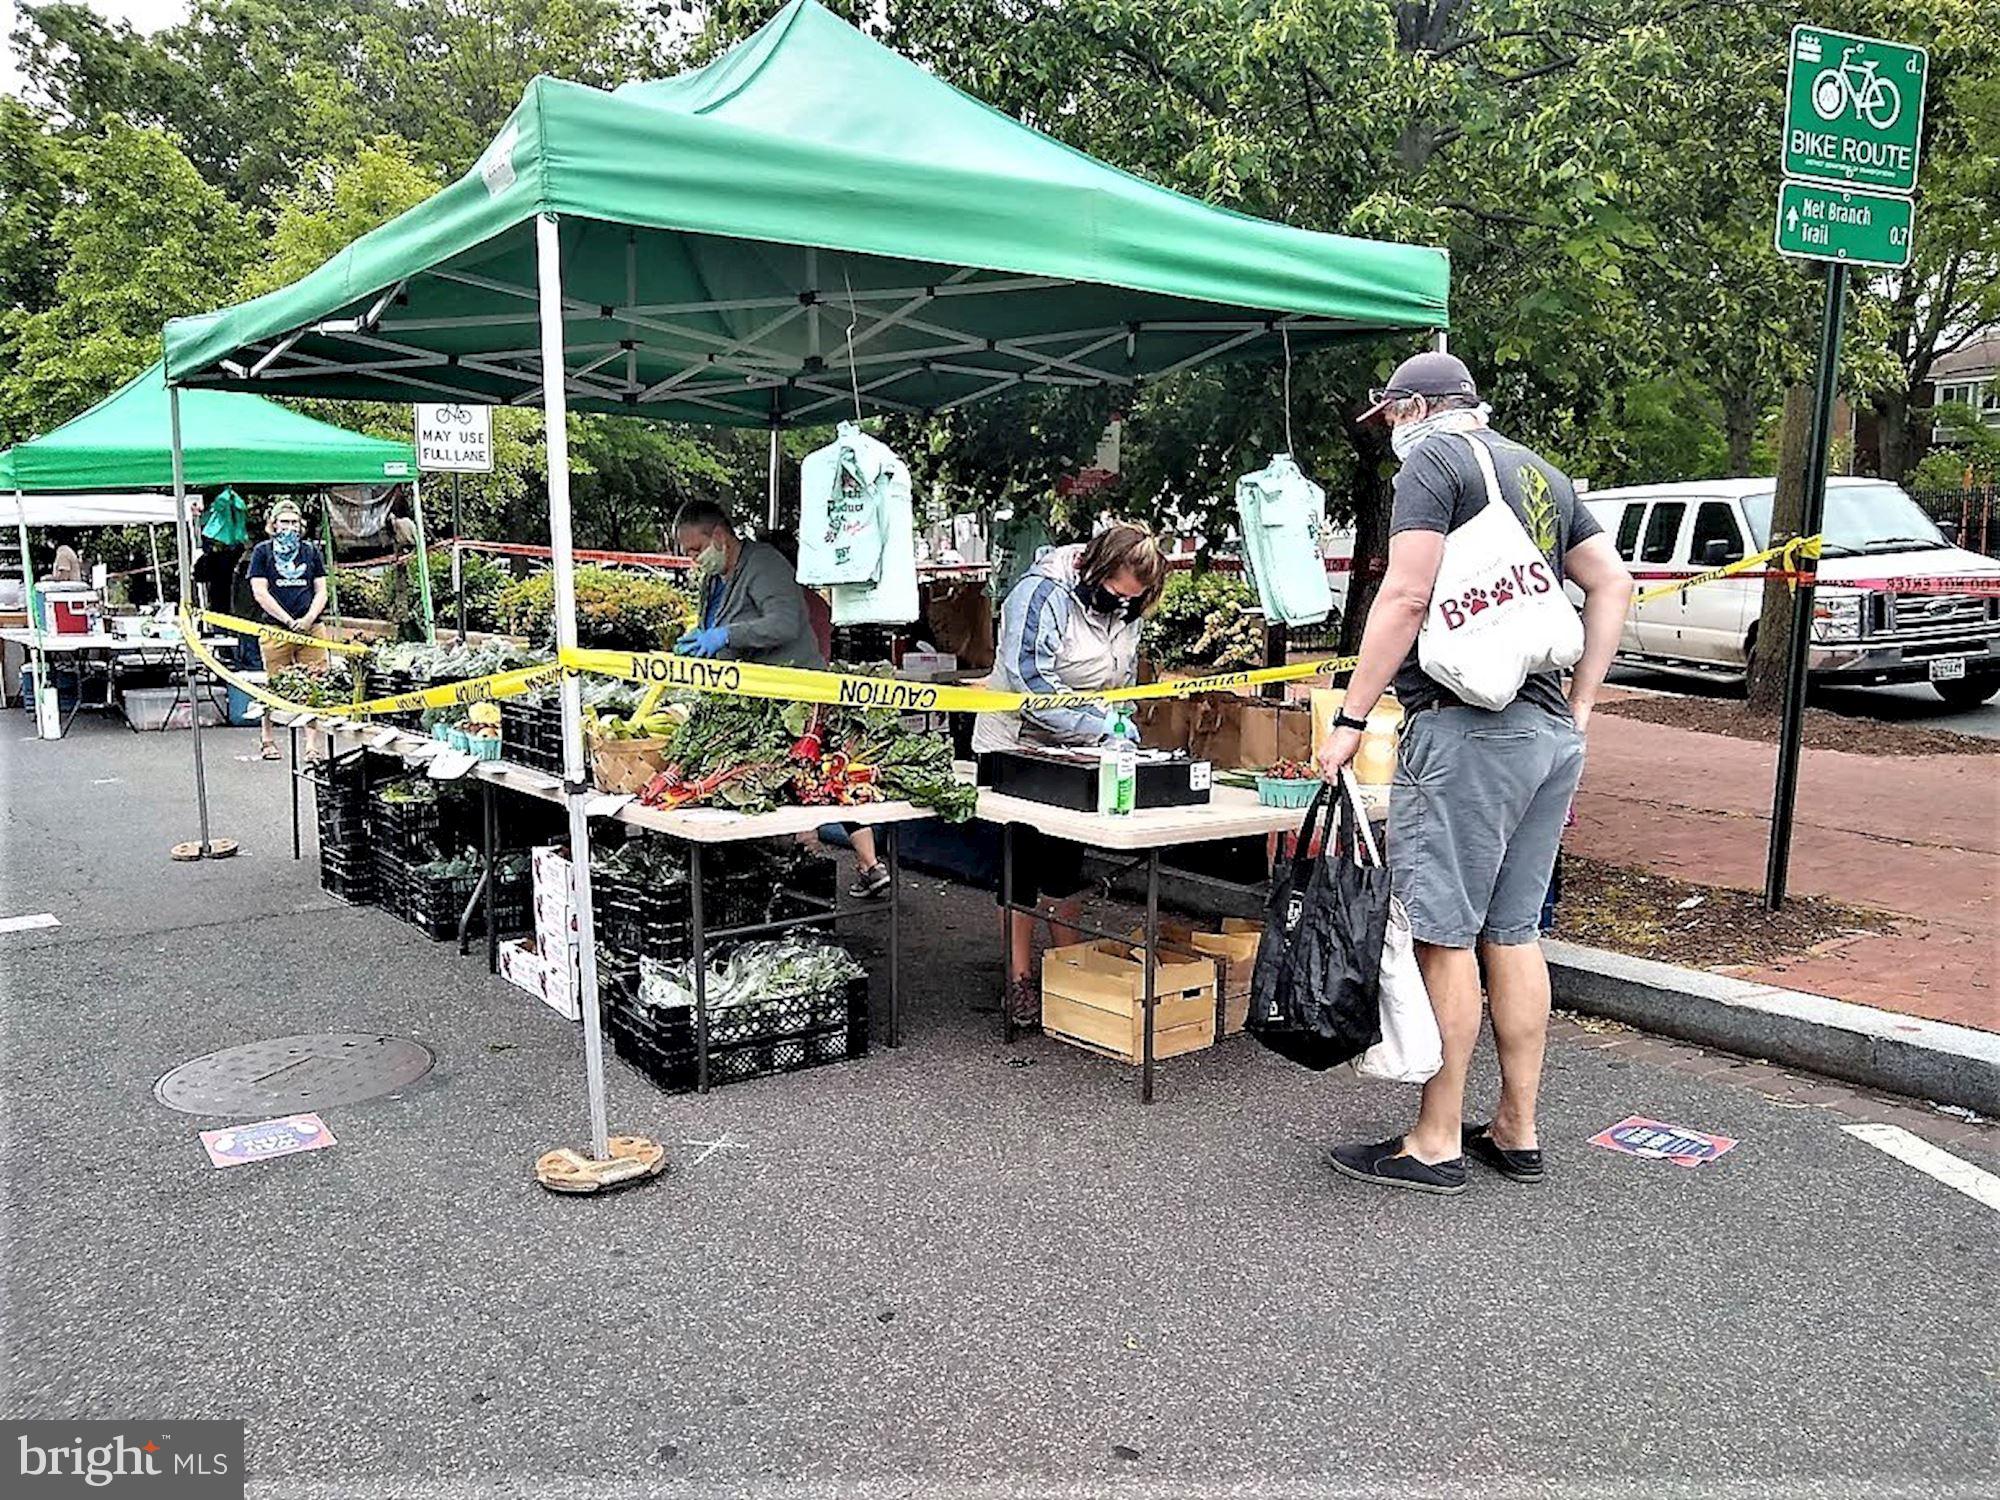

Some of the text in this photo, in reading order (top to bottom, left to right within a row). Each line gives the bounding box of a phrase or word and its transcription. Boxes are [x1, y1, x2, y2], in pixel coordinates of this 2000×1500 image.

[1790, 129, 1838, 160] BIKE
[1841, 137, 1912, 171] ROUTE
[1802, 198, 1872, 226] Met Branch
[1801, 222, 1909, 247] Trail 0.7
[423, 430, 485, 445] MAY USE
[423, 447, 486, 463] FULL LANE
[632, 656, 740, 691] CAUTION
[840, 679, 937, 708] CAUTION
